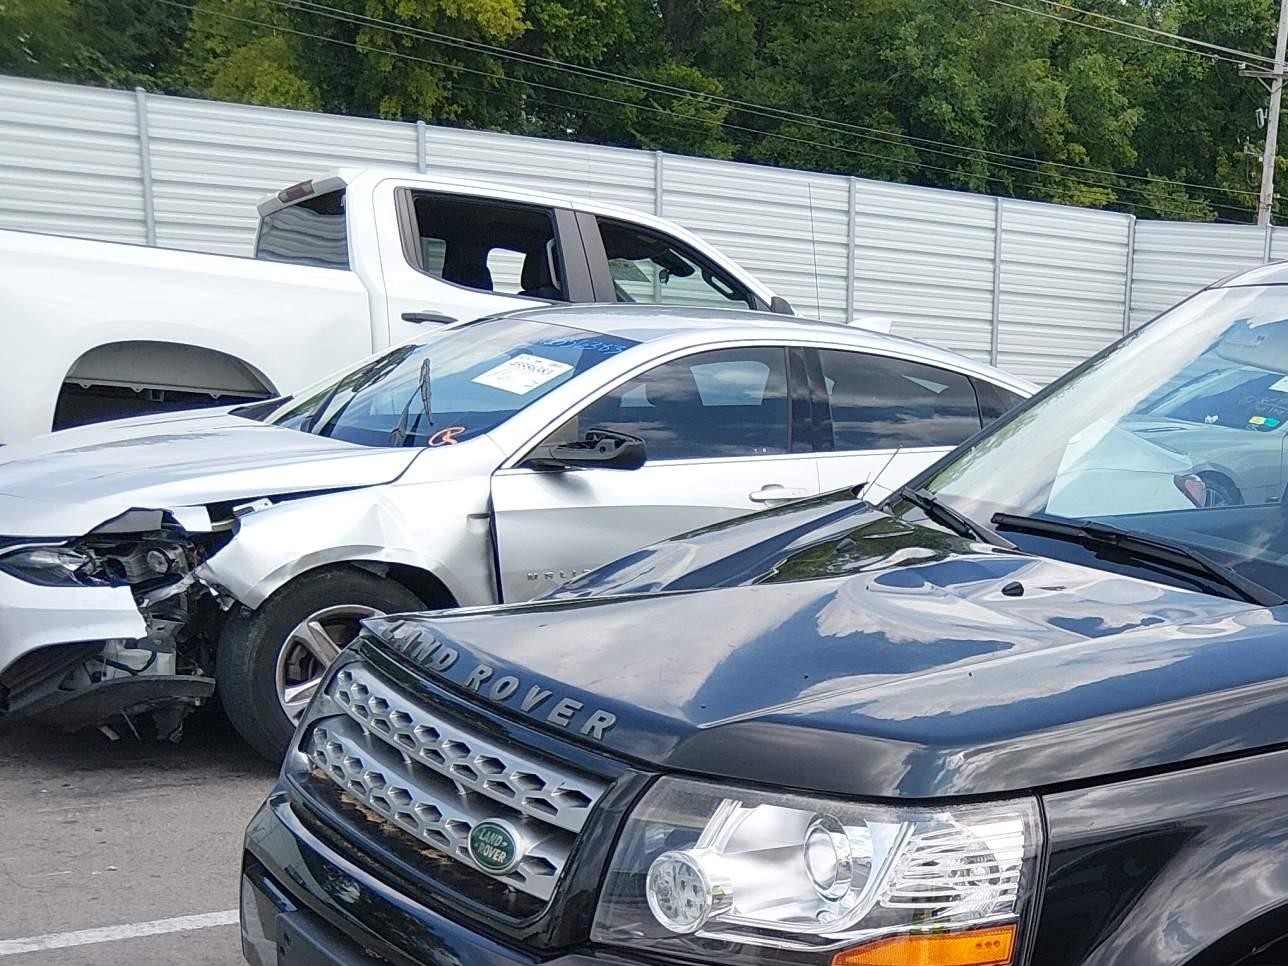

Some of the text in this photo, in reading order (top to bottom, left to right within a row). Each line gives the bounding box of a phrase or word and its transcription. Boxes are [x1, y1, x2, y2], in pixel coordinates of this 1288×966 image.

[381, 619, 617, 740] LAND ROVER
[478, 829, 504, 847] LAND
[477, 842, 507, 864] ROVER
